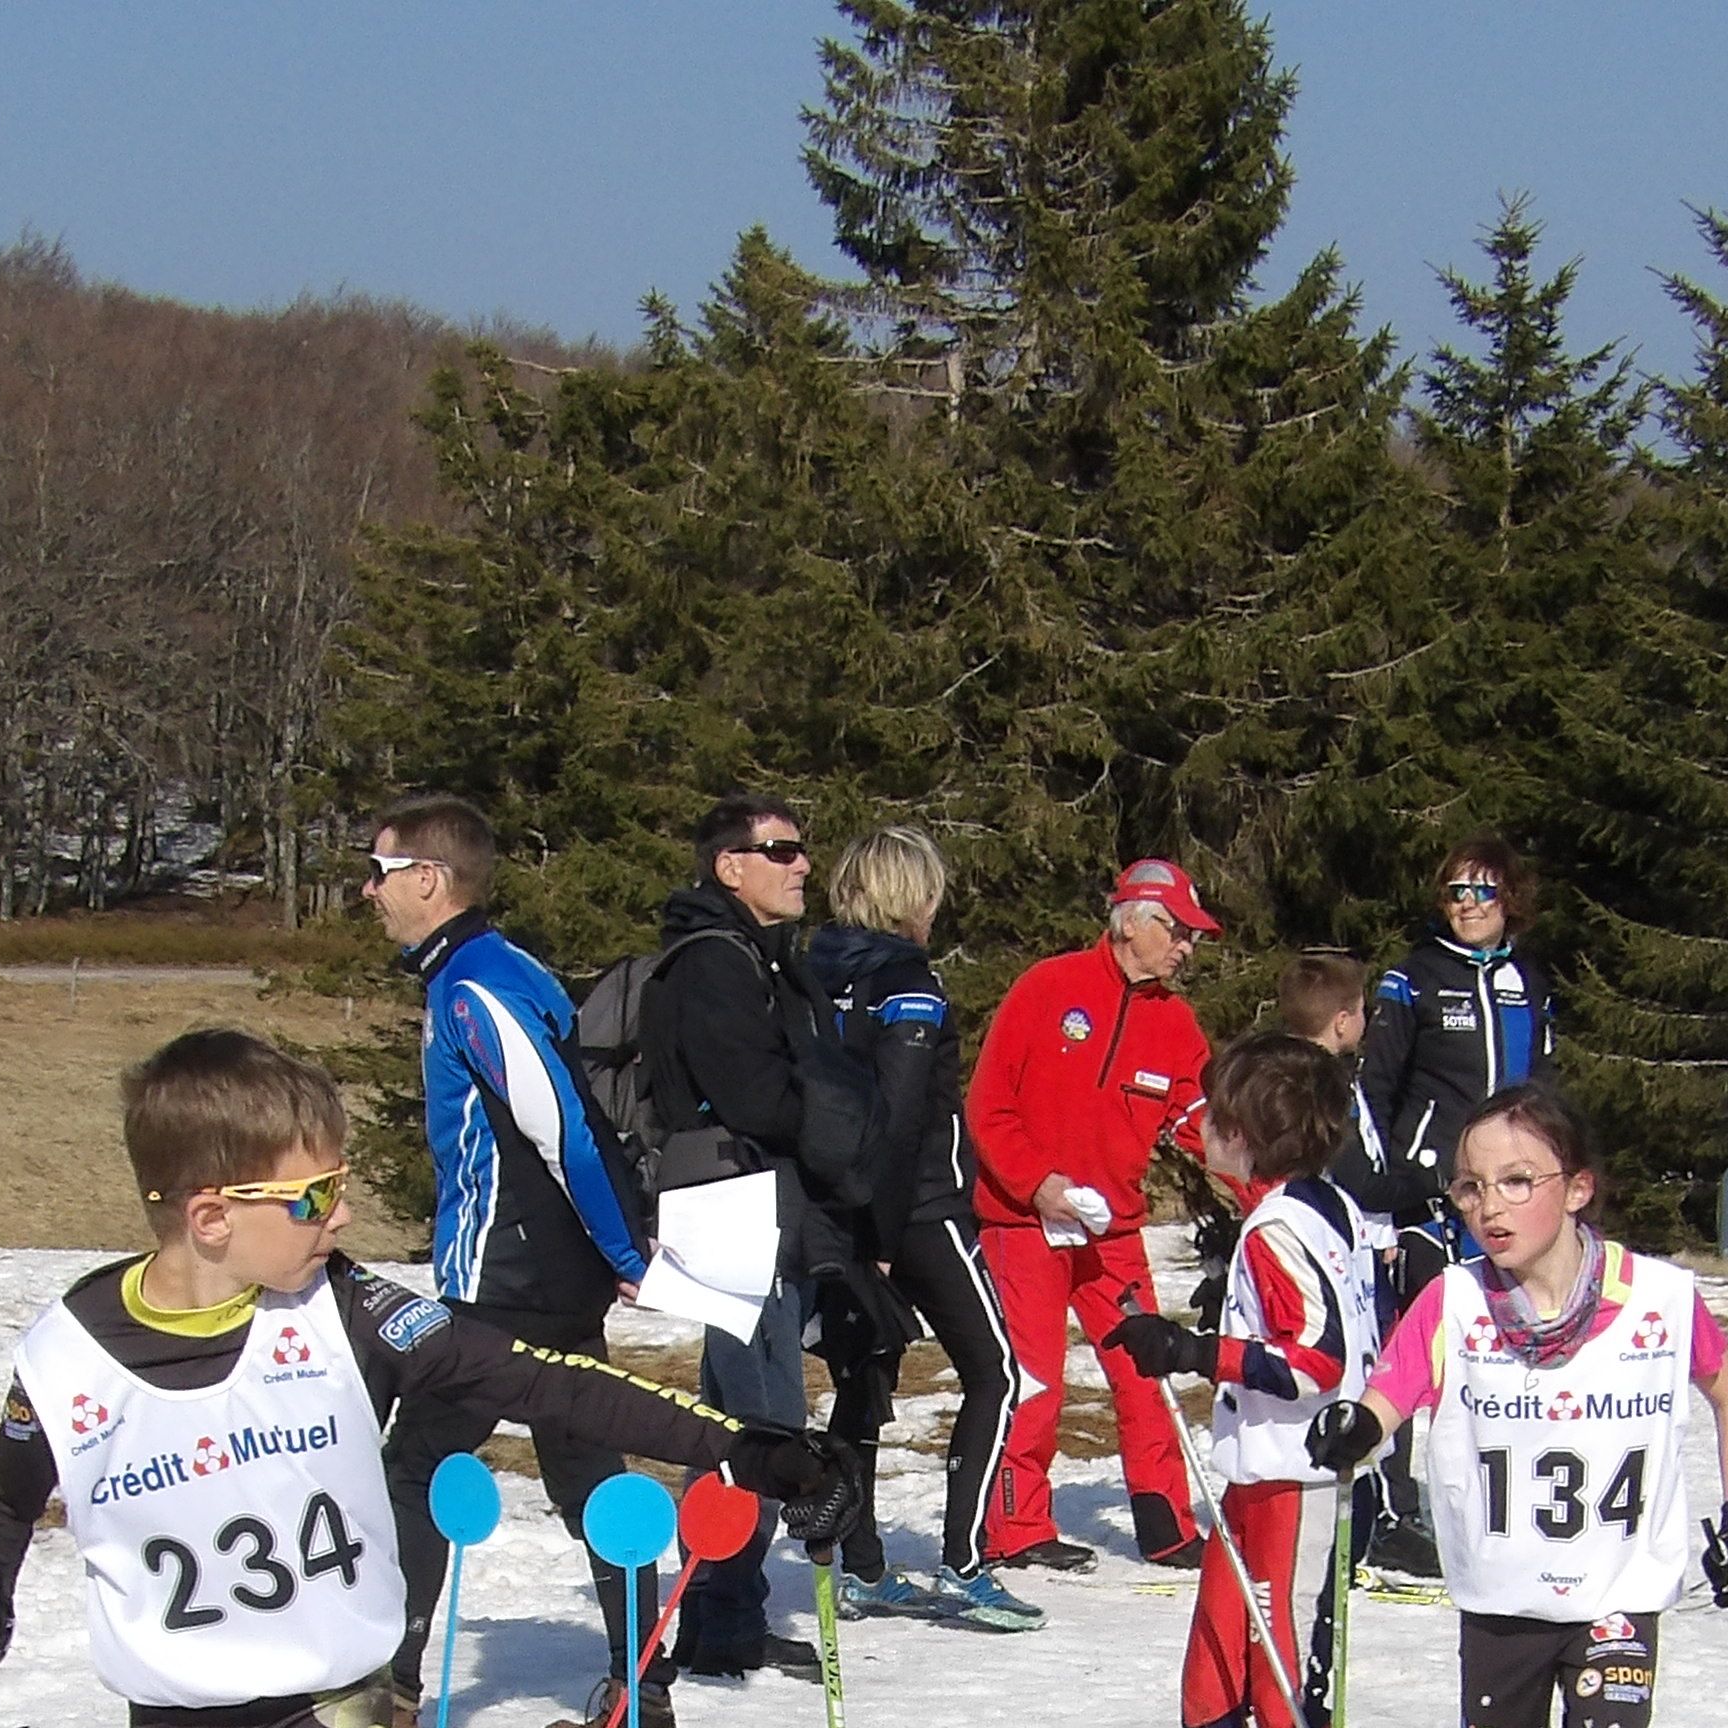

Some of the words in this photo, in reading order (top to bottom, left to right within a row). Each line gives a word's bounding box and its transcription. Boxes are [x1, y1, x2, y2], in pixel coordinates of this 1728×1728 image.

[1476, 1444, 1649, 1543] 134
[141, 1488, 365, 1633] 234
[1604, 1666, 1653, 1687] spor
